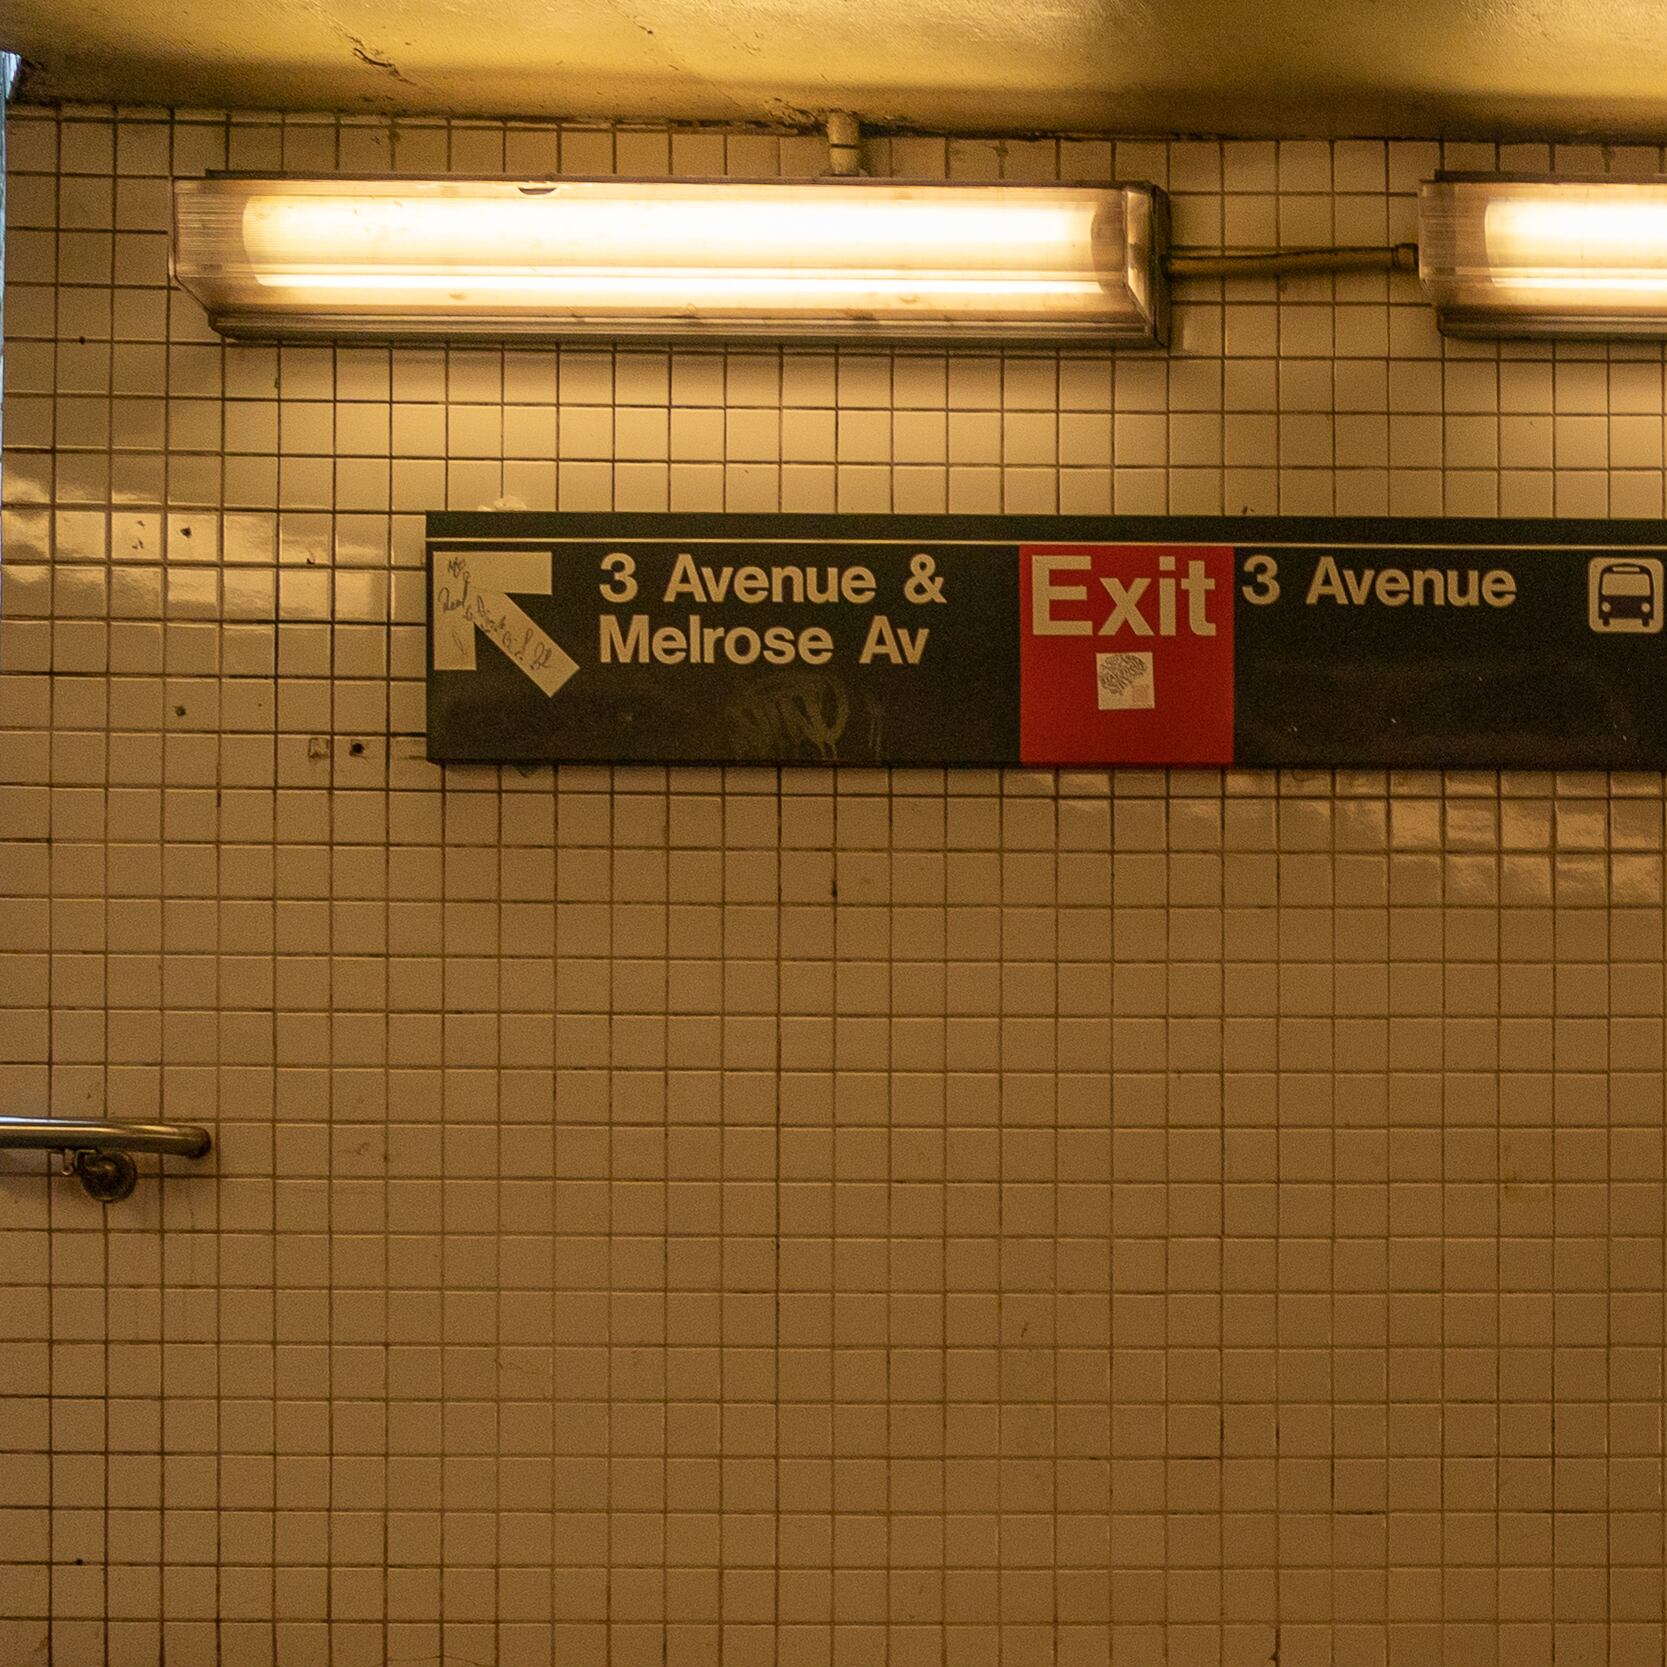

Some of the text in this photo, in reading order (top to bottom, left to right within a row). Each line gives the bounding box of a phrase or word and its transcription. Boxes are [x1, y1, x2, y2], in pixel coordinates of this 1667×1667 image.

[600, 553, 946, 604] 3 Avenue &
[1031, 554, 1217, 637] Exit
[1242, 555, 1517, 607] 3 Avenue
[600, 614, 834, 665] Melrose
[859, 615, 929, 664] Av
